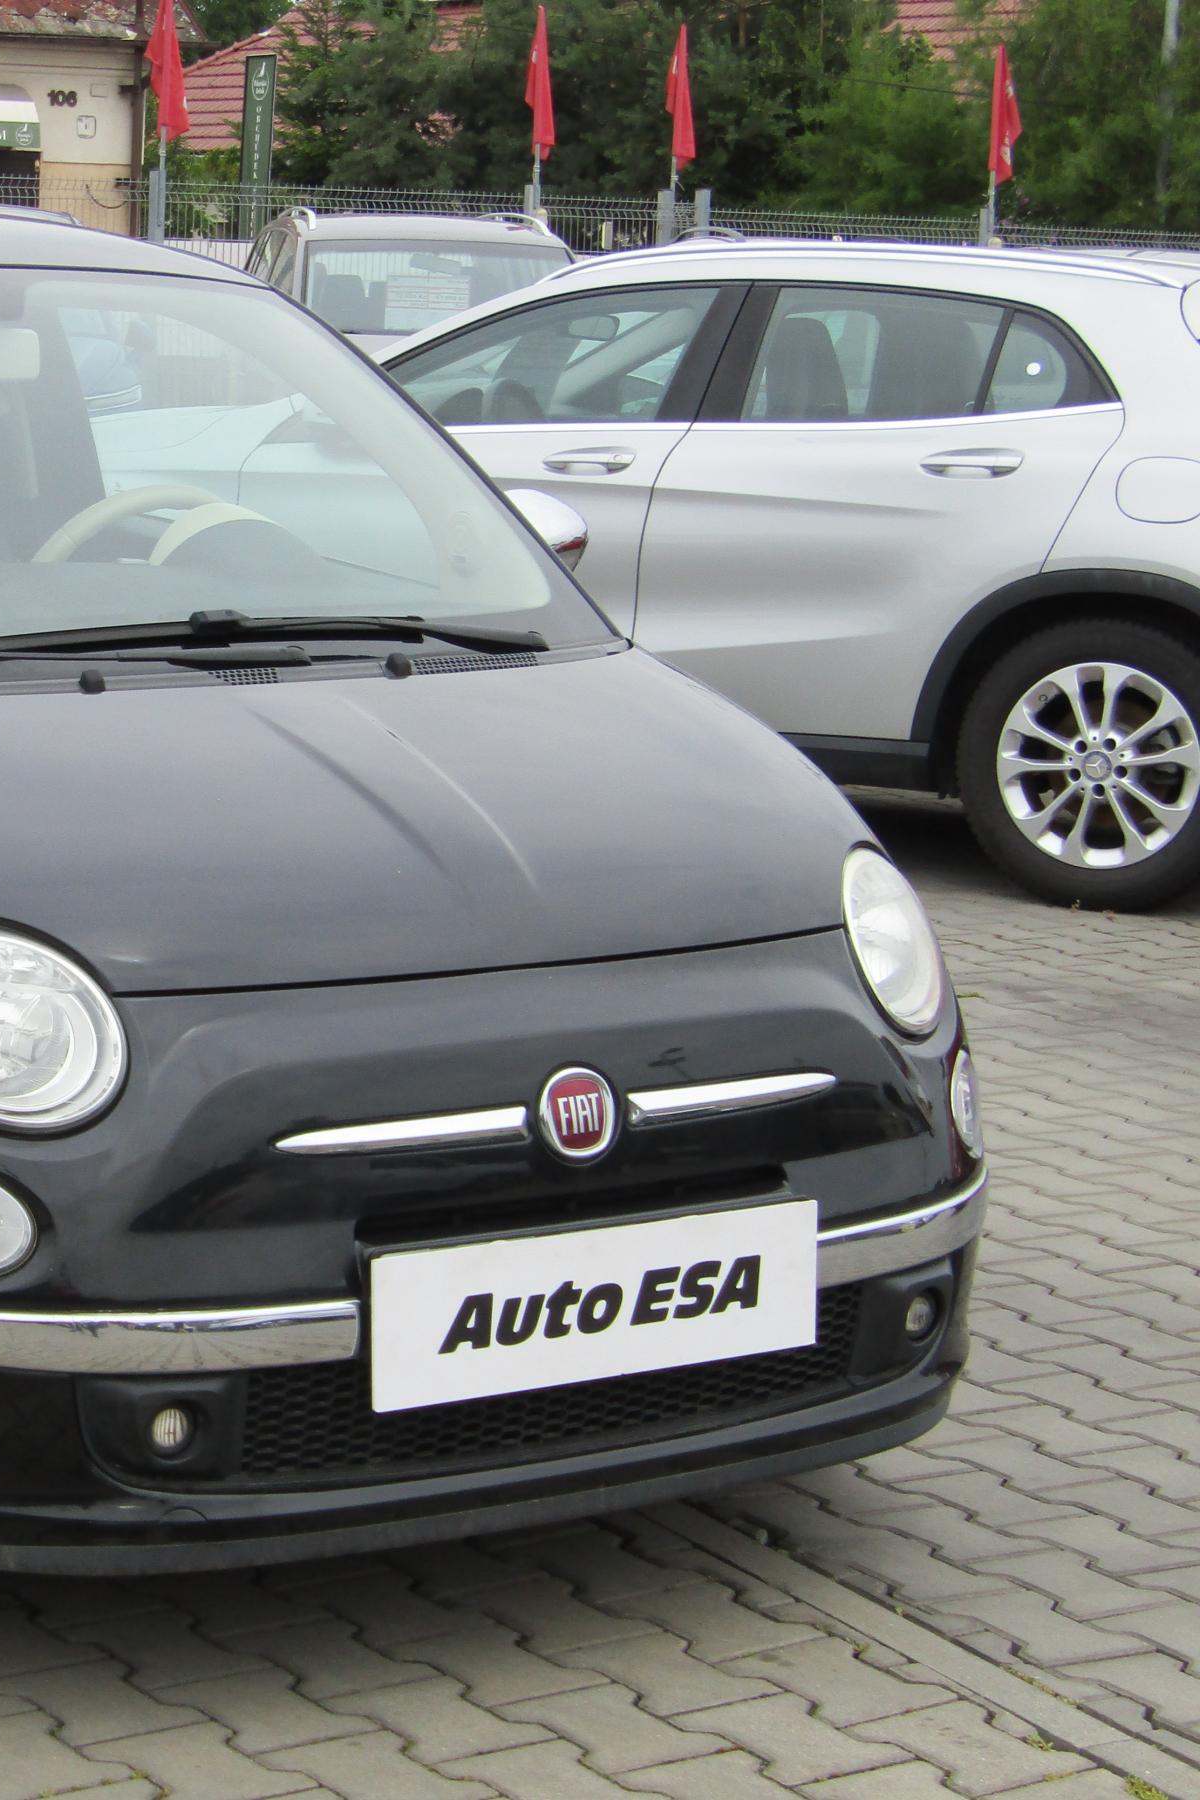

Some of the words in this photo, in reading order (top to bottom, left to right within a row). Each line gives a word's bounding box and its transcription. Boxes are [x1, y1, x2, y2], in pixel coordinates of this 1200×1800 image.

[48, 90, 77, 107] 106
[557, 1092, 599, 1136] FIAT
[438, 1280, 623, 1354] Auto
[630, 1255, 761, 1326] ESA
